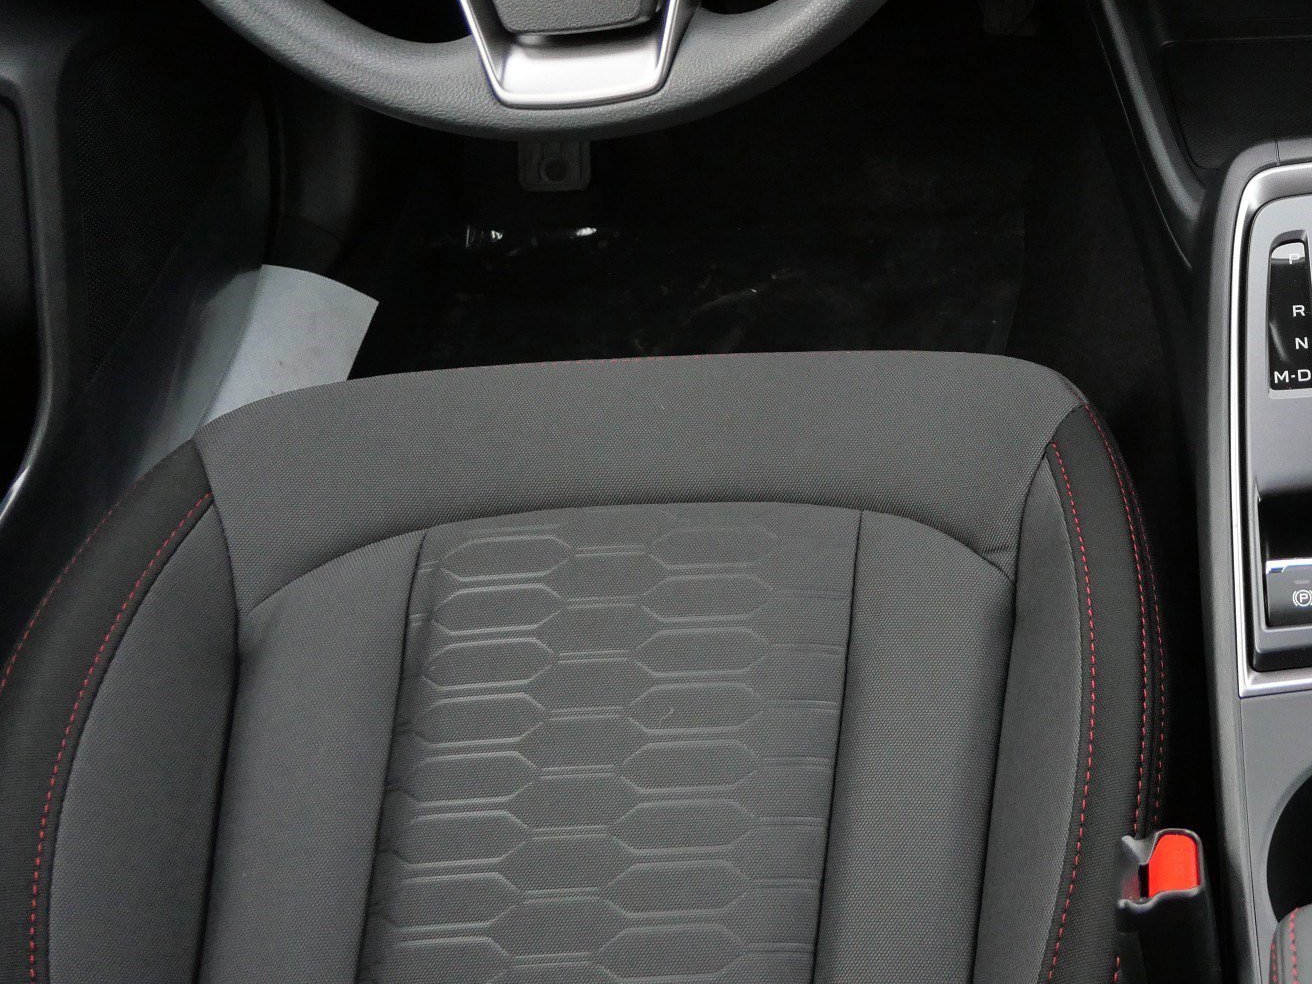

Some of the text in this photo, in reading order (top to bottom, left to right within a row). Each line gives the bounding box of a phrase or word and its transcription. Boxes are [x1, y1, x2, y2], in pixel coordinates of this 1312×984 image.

[1289, 253, 1300, 264] P
[1292, 305, 1306, 317] R
[1295, 337, 1309, 350] N
